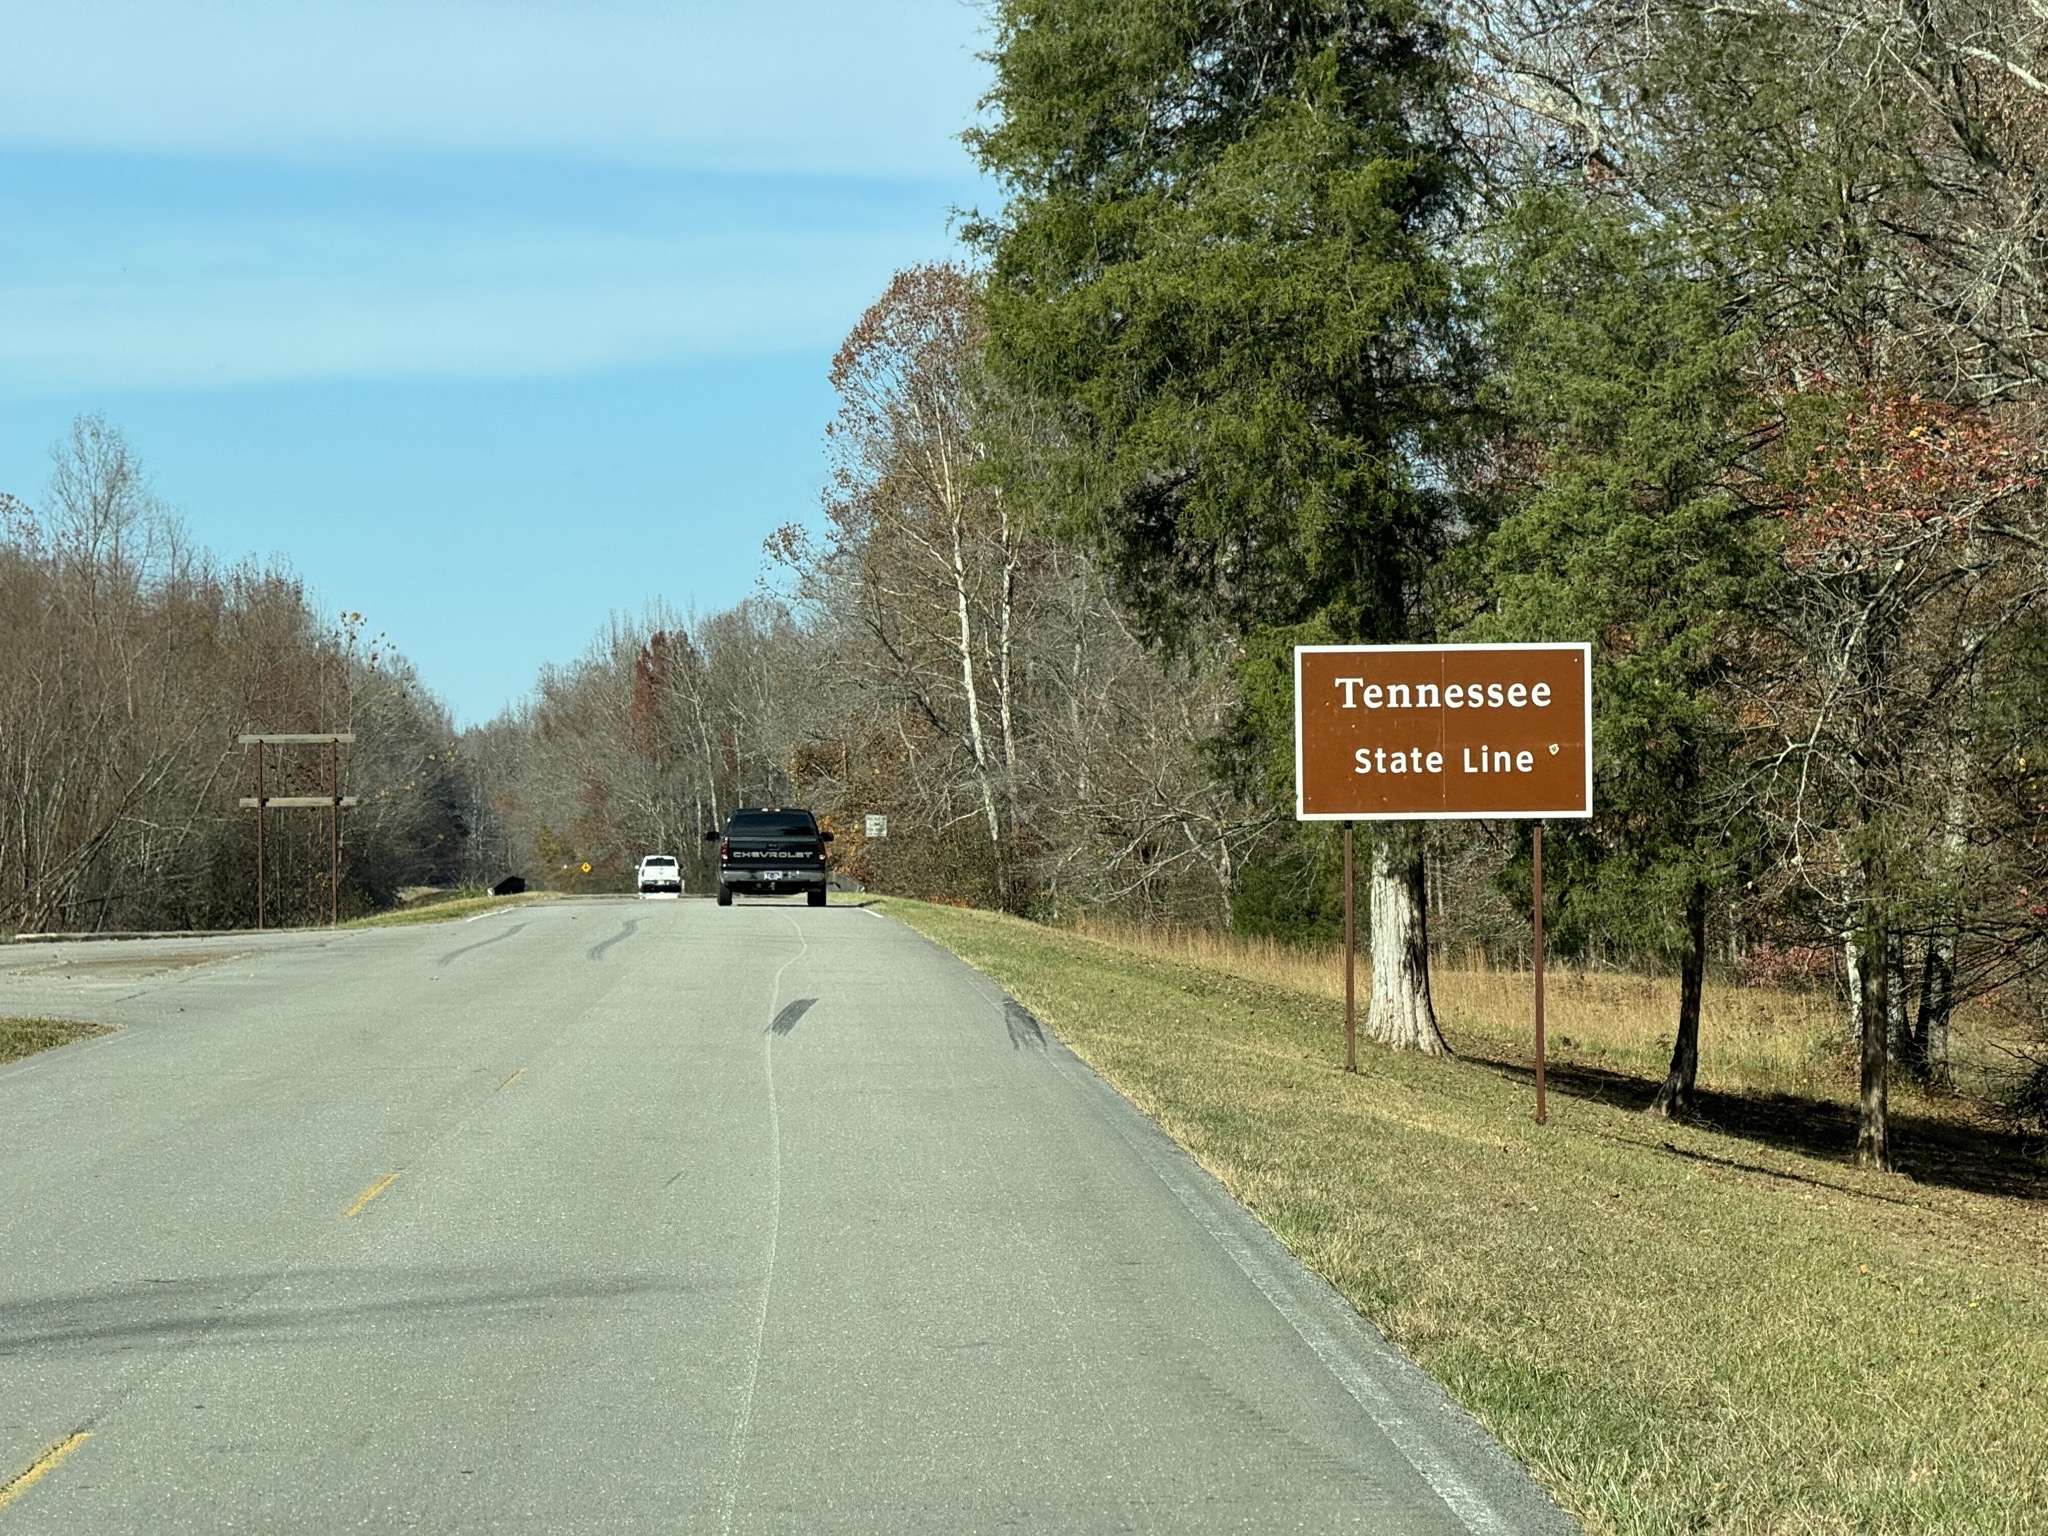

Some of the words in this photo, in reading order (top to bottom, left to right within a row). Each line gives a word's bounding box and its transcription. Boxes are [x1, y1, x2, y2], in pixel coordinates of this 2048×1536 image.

[1335, 678, 1551, 708] Tennessee
[1355, 748, 1443, 773] State
[1464, 745, 1534, 772] Line
